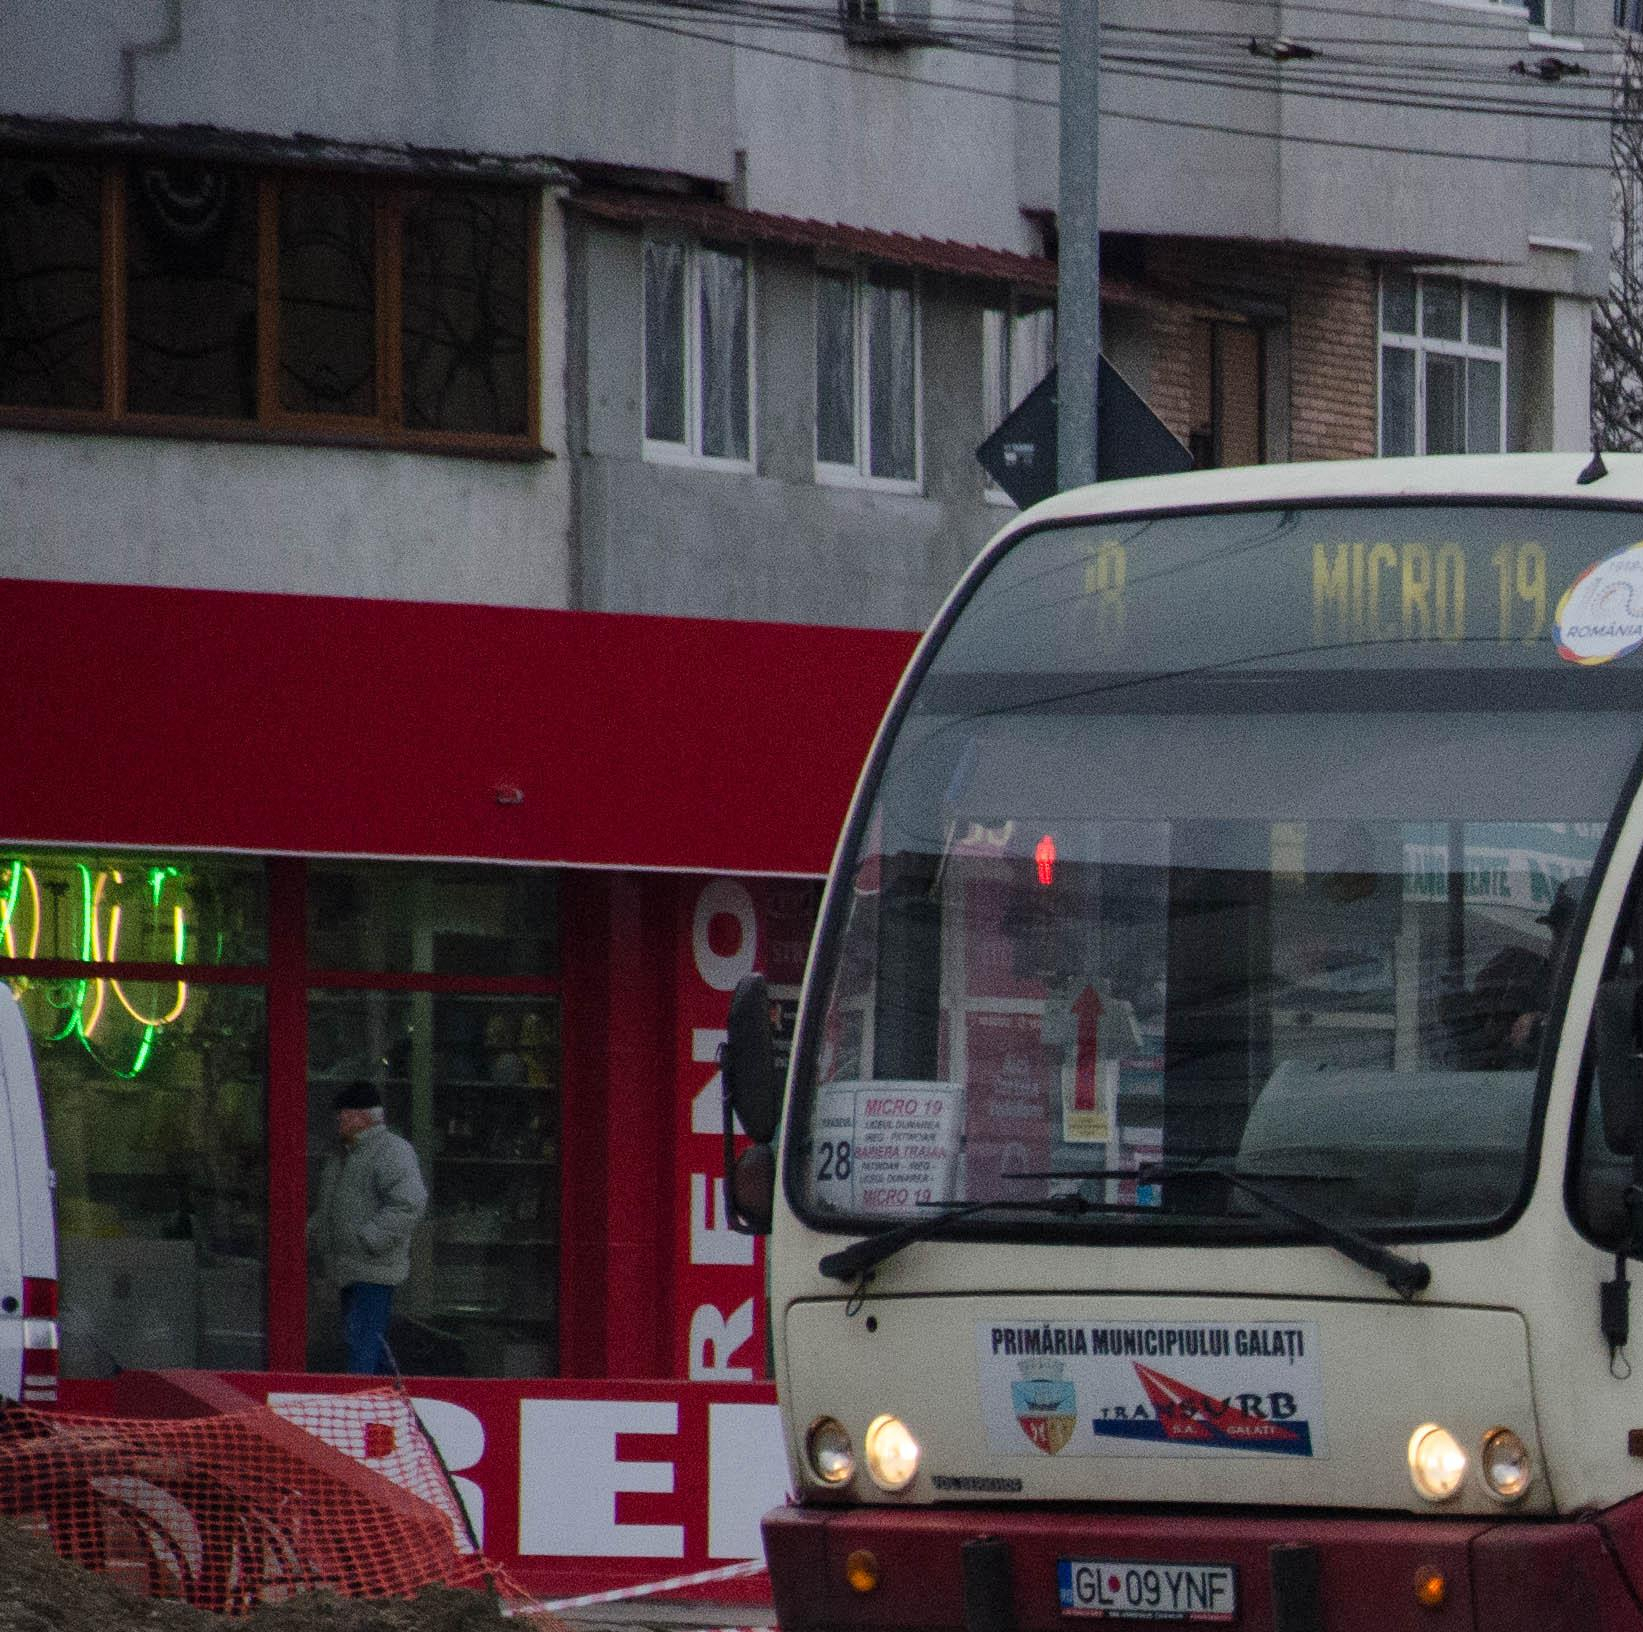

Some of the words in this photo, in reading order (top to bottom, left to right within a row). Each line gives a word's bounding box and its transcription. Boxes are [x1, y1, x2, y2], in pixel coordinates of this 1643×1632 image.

[1311, 541, 1467, 644] MICRO
[1491, 542, 1549, 646] 19
[864, 1099, 918, 1116] MICRO
[925, 1099, 943, 1114] 19
[818, 1141, 851, 1181] 28
[863, 1189, 909, 1207] MICRO
[914, 1189, 932, 1204] 19
[991, 1322, 1087, 1356] PRIMĂRIA
[1092, 1326, 1230, 1359] MUNICIPIULUI
[1100, 1392, 1298, 1420] TRANSURB
[1076, 1566, 1114, 1605] GL
[1126, 1569, 1160, 1606] 09
[1164, 1571, 1227, 1609] YNF
